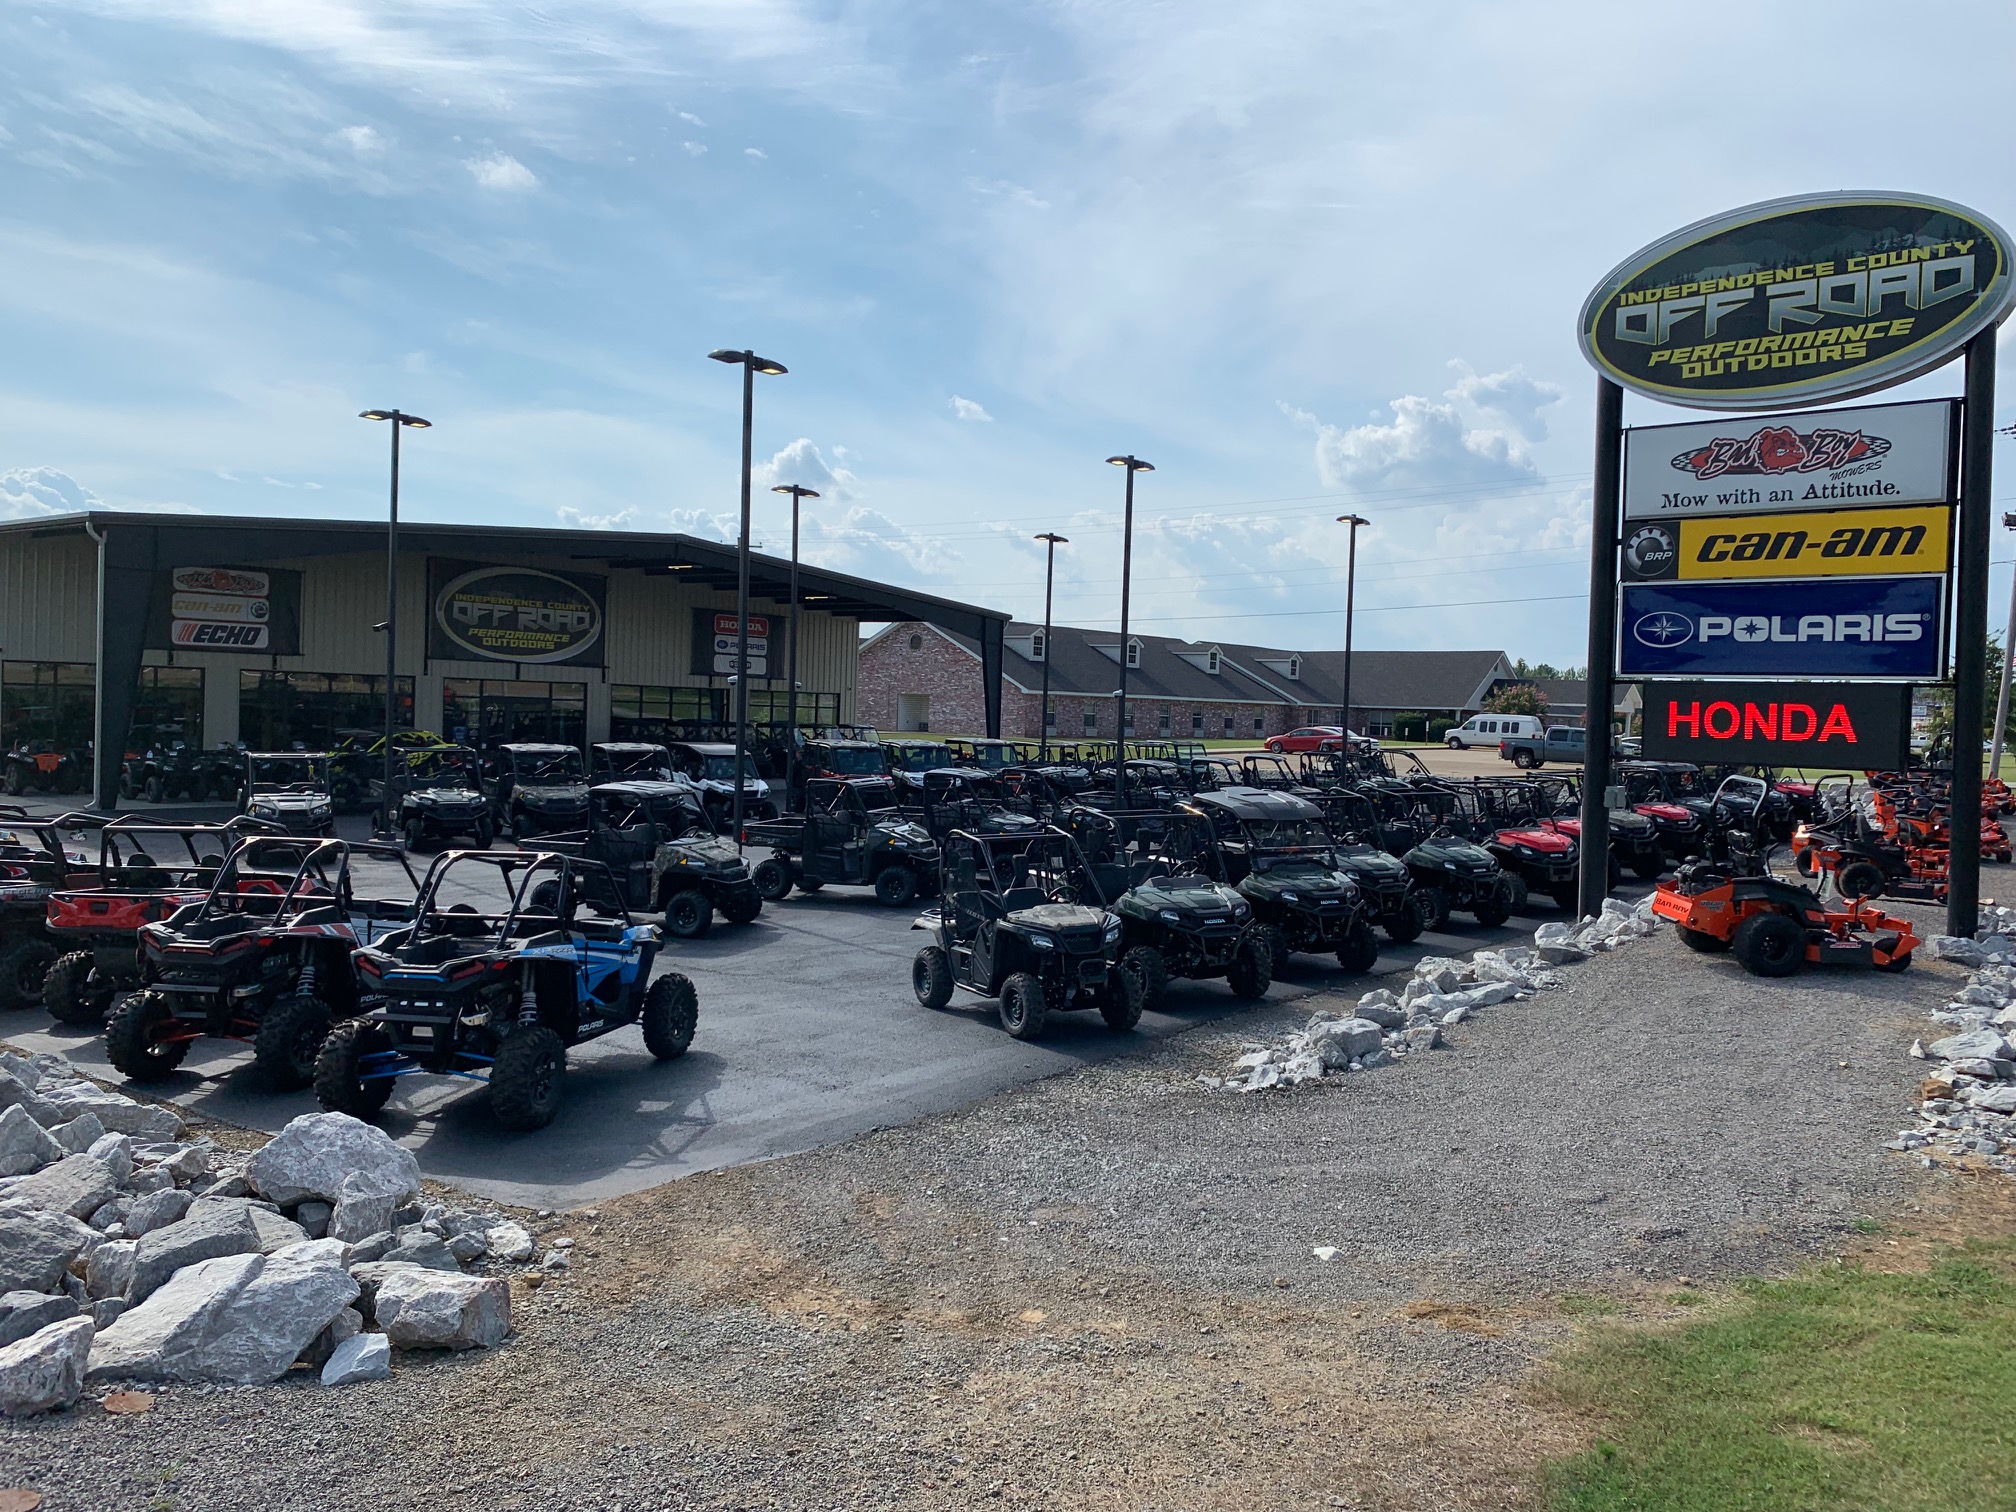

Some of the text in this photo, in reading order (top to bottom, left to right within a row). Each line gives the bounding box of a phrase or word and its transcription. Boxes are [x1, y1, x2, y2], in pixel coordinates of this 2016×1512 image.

[1620, 239, 1975, 306] INDEPENDENCE COUNTY
[1615, 254, 1976, 346] OFF ROAD
[1648, 318, 1916, 367] PERFORMANCE
[1681, 342, 1867, 379] OUTDOORS
[1829, 460, 1882, 481] MOWERS
[1661, 480, 1901, 509] Mow with an Attitude.
[1644, 551, 1673, 562] BRP
[1696, 525, 1927, 563] can-am
[455, 593, 591, 612] INDEPENDENCE COUNTY
[452, 601, 590, 633] OFF ROAD
[720, 620, 763, 631] HODA
[1699, 613, 1923, 643] POLARIS
[193, 624, 262, 645] ECHO
[468, 628, 571, 643] PERFORMANCE
[482, 638, 555, 650] OUTDOORS
[730, 642, 765, 650] PARIS
[1668, 700, 1858, 744] HONDA
[1656, 898, 1671, 907] BAD
